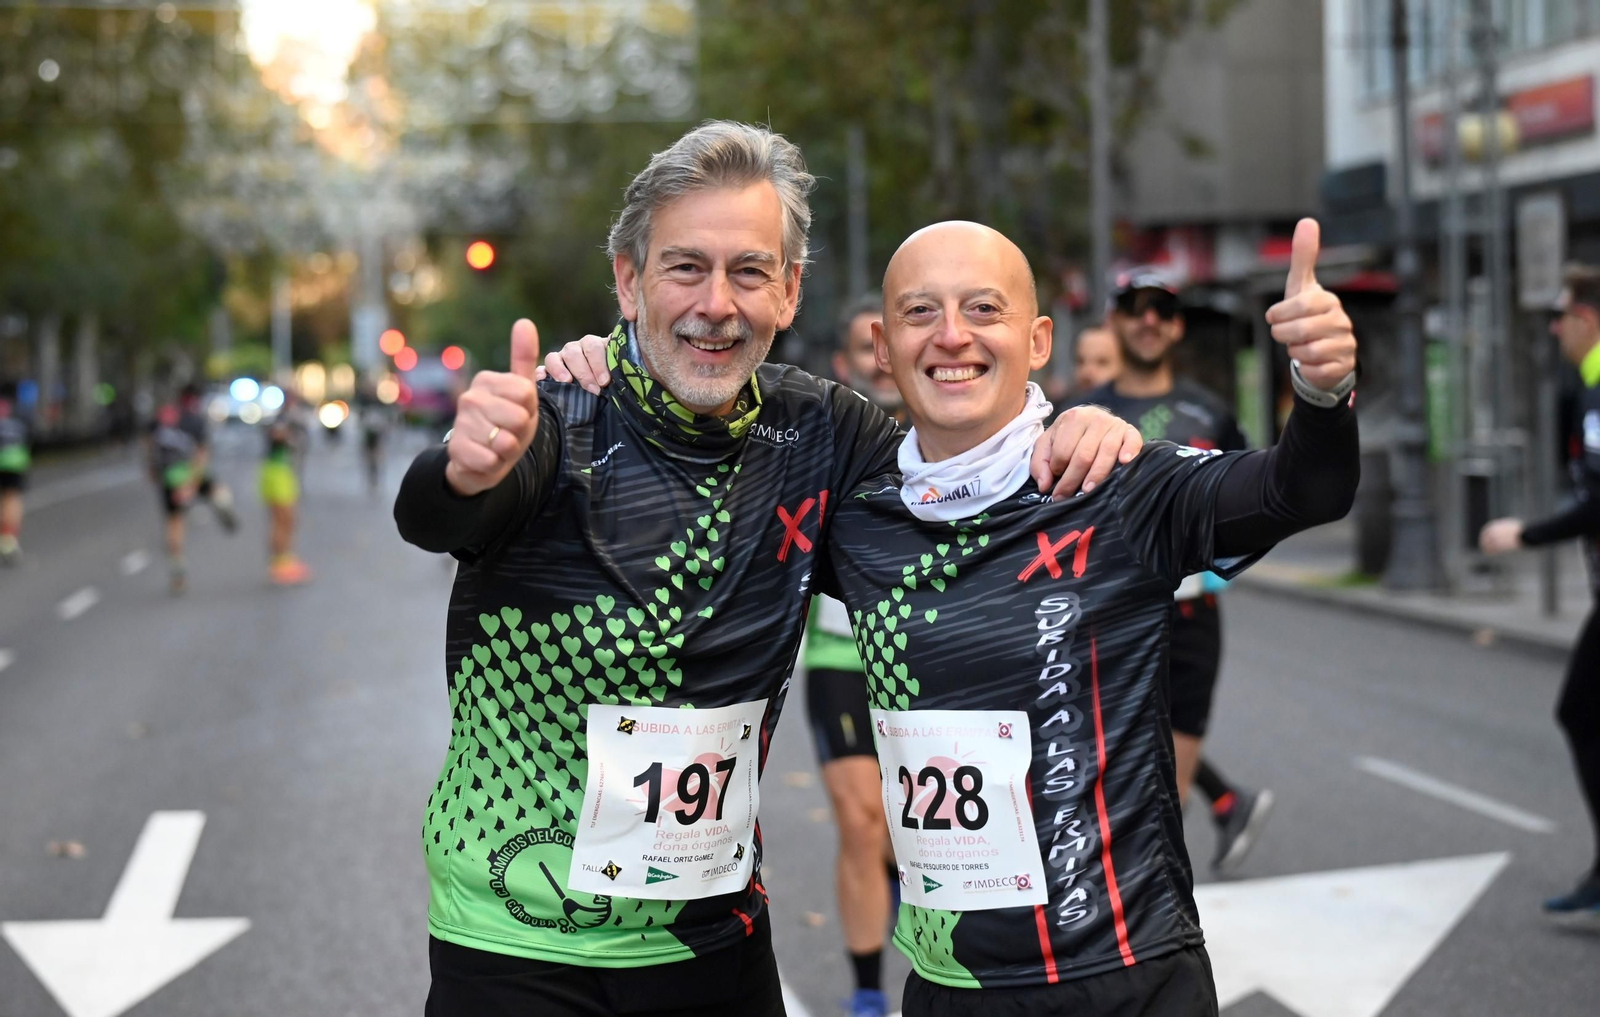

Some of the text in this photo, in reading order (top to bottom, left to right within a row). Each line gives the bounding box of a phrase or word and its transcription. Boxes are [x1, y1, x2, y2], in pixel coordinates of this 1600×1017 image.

[1017, 526, 1095, 583] XI
[633, 717, 746, 735] SUBIDA A LAS ERMITAS
[912, 727, 920, 738] A
[922, 726, 942, 738] LAS
[1034, 597, 1089, 926] SUBIDA A LAS ERMITAS
[633, 757, 737, 826] 197
[898, 765, 989, 831] 228
[655, 829, 701, 841] Regala
[916, 835, 990, 848] Regala VIDA,
[653, 836, 733, 851] dona órganos
[491, 836, 527, 877] AMIGOS
[527, 831, 552, 844] DEL
[642, 854, 672, 863] RAFAEL
[673, 855, 693, 863] ORTIZ
[918, 848, 999, 860] dona órganos
[710, 862, 738, 877] IMDECO
[909, 860, 923, 869] RAFAEL
[923, 862, 951, 871] PESQUERO
[951, 863, 960, 871] DE
[974, 876, 1017, 889] IMDECO
